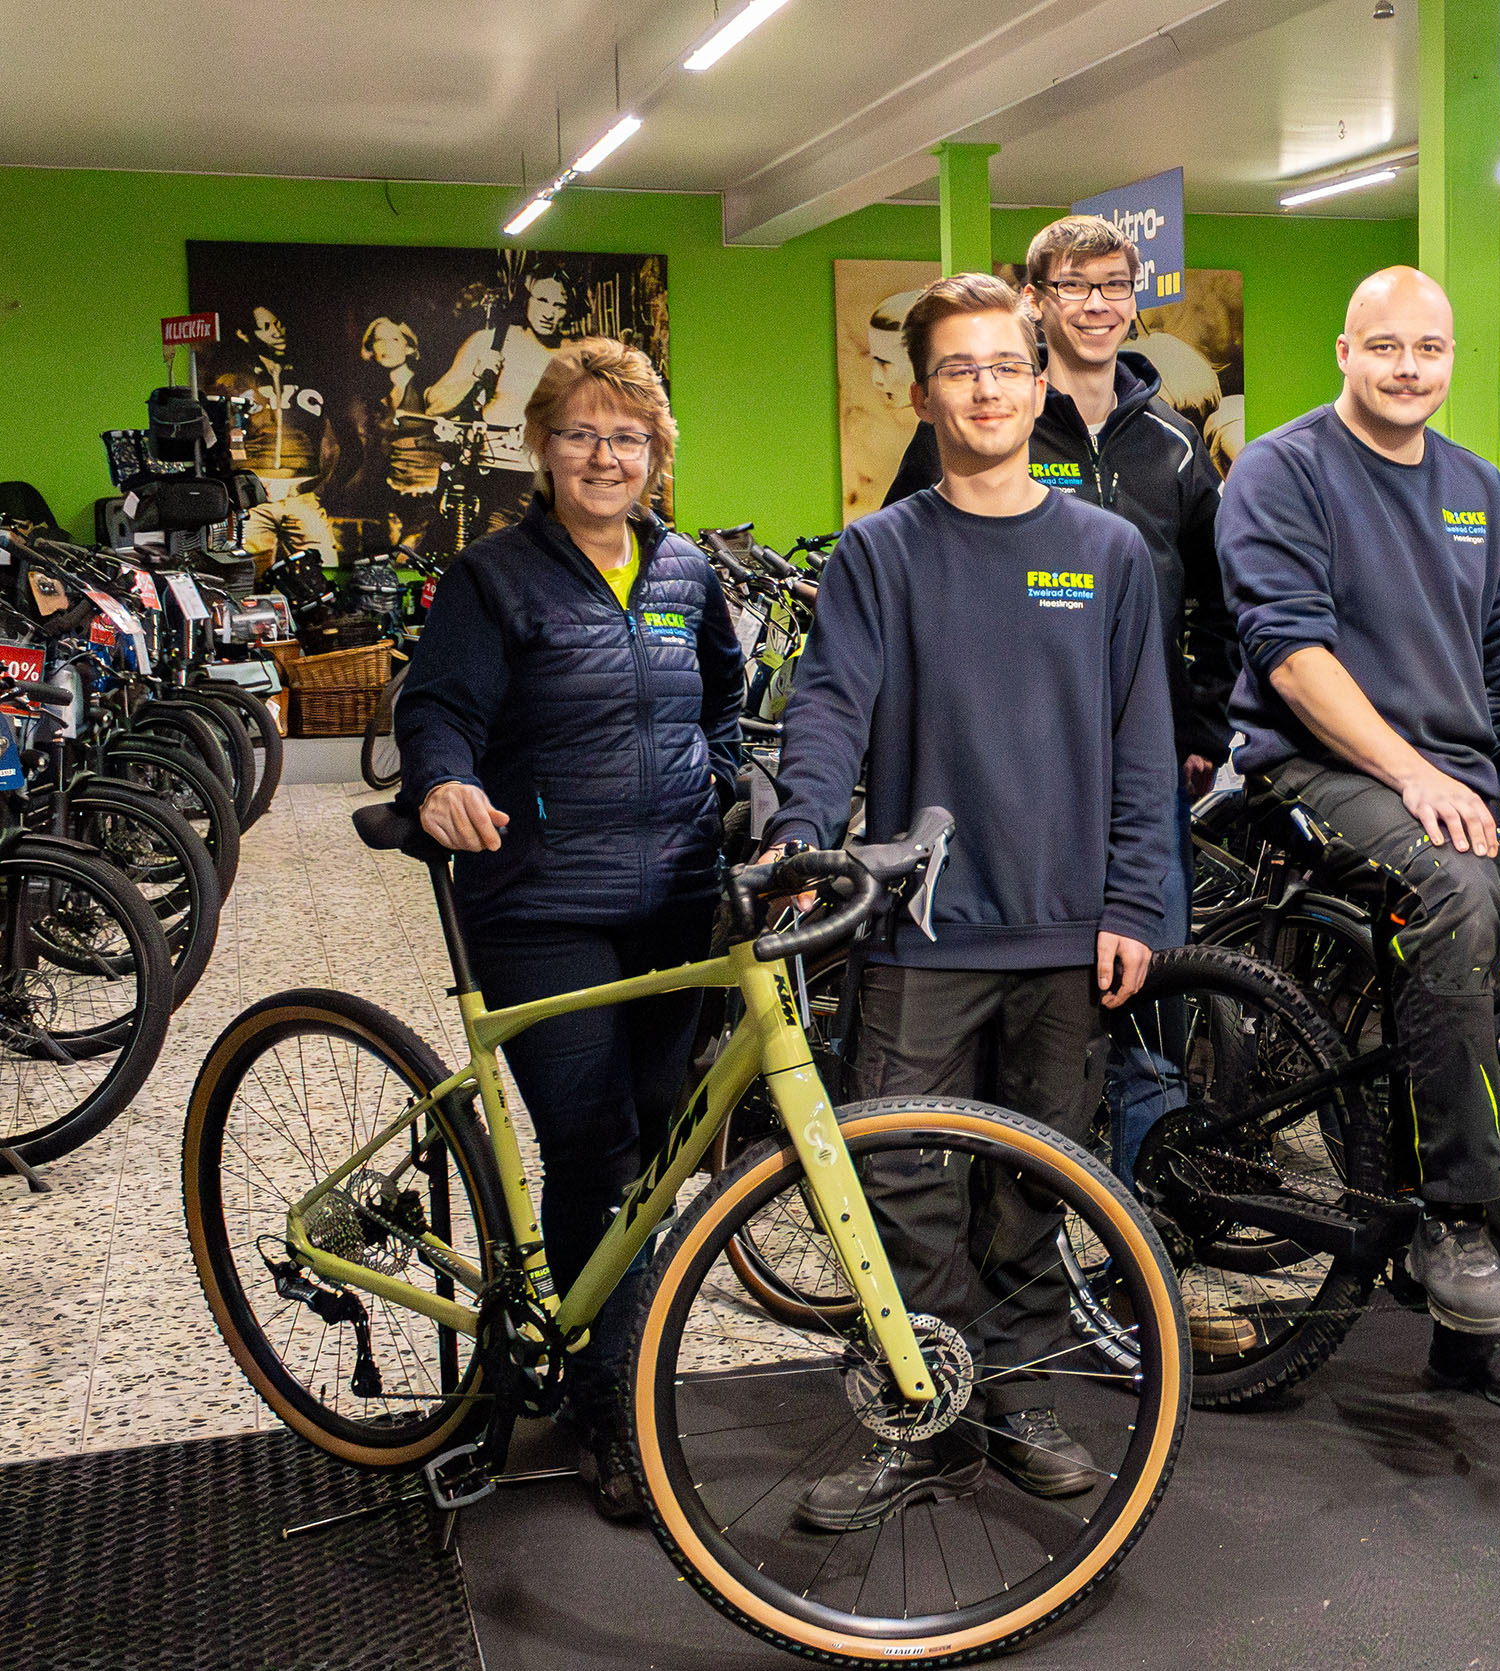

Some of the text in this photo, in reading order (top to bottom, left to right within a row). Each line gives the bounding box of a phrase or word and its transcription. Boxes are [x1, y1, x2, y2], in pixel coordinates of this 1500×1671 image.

[1112, 208, 1165, 243] ktro-
[1028, 588, 1094, 599] Zweirad Center
[1039, 599, 1084, 610] Heeslingen
[3, 659, 40, 682] 0%
